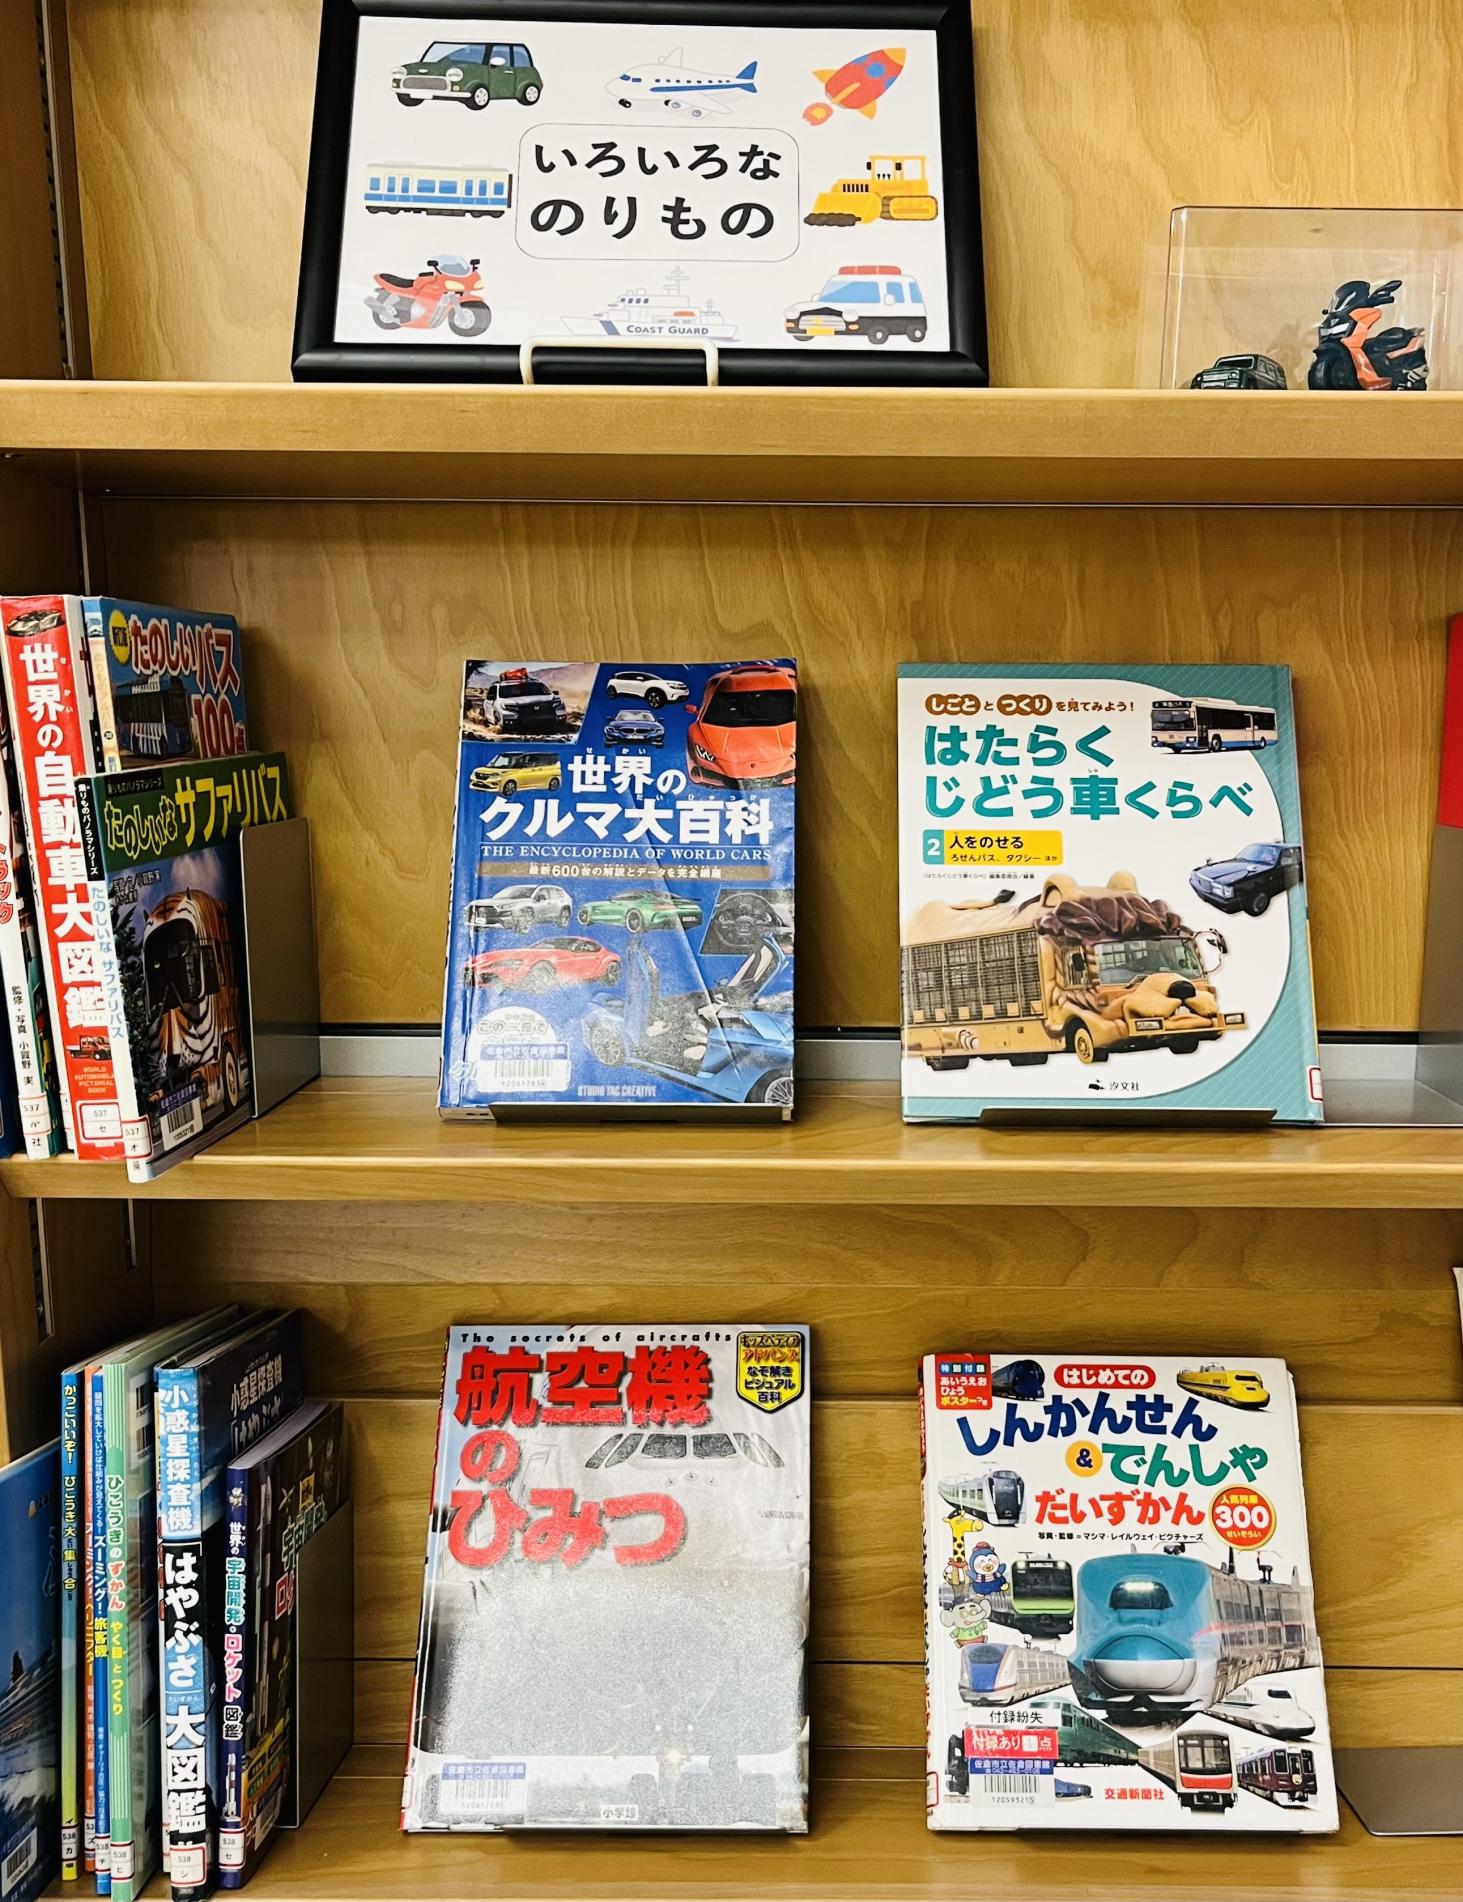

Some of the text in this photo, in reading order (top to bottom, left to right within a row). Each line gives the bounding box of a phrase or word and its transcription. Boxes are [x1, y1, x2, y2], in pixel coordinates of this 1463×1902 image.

[534, 141, 782, 181] いろいろな
[529, 195, 775, 241] のりもの
[626, 325, 709, 336] COAST GUARD
[128, 614, 241, 696] たのしいバス
[929, 696, 978, 714] しごと
[999, 696, 1050, 714] つくり
[924, 724, 1115, 768] はたらく
[567, 754, 687, 795] 世界の
[104, 795, 178, 860] たのしいな
[174, 764, 288, 848] サファリバス
[925, 773, 1255, 821] じどう車くらべ
[19, 643, 108, 1029] 世界の自動車大図鑑
[479, 795, 774, 845] クルマ大百科
[481, 845, 772, 862] THE ENCYCLOPEDIA OF WORLD CARS
[926, 838, 941, 857] 2
[949, 835, 1024, 850] 人をのせる
[23, 1103, 40, 1113] 537
[93, 1109, 108, 1118] 537
[124, 1127, 140, 1137] 537
[461, 1332, 732, 1344] The secrets of aircrafts
[453, 1345, 713, 1428] 航空機
[939, 1376, 988, 1387] あいうえお
[940, 1386, 966, 1397] ひょう
[1062, 1366, 1150, 1386] はじめての
[757, 1391, 782, 1404] 百科
[64, 1384, 77, 1464] かっこいいぞ!
[956, 1390, 1219, 1457] しんかんせん
[163, 1384, 194, 1532] 小惑星探査機
[459, 1429, 521, 1485] の
[1075, 1442, 1269, 1488] & でんしゃ
[1034, 1487, 1207, 1527] だいずかん
[1214, 1505, 1270, 1530] 300
[106, 1474, 126, 1612] ひこうきのずかん
[449, 1487, 689, 1569] ひみつ
[94, 1535, 107, 1615] ズーミング!
[990, 1710, 1044, 1724] 付録紛失
[1104, 1786, 1165, 1801] 交通新聞社
[62, 1832, 77, 1841] 538
[113, 1851, 127, 1859] 538
[178, 1855, 192, 1863] 538
